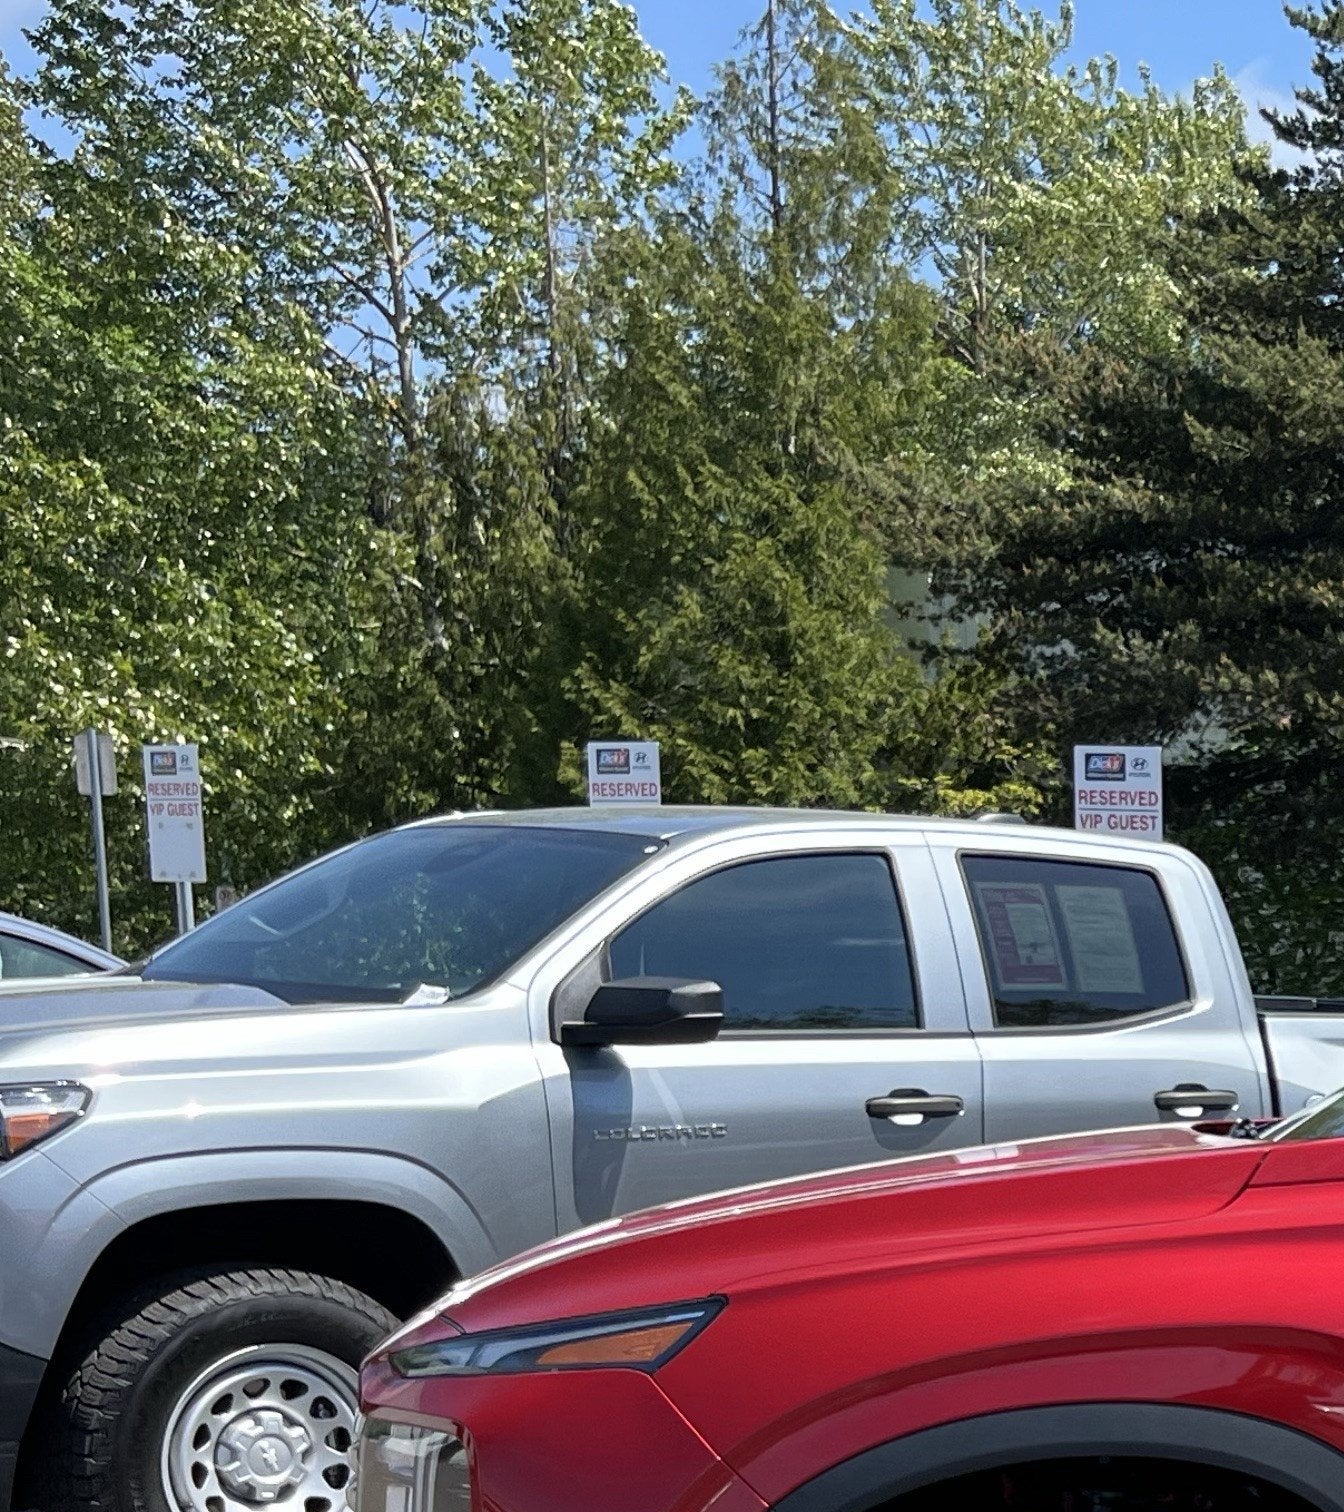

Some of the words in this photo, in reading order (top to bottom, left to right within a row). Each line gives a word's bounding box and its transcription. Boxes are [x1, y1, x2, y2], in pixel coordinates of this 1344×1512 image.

[148, 783, 199, 796] RESERVED
[592, 783, 658, 797] RESERVED
[1079, 790, 1159, 807] RESERVED
[149, 803, 165, 816] VIP
[167, 803, 199, 817] GUEST
[1080, 814, 1103, 829] VIP
[1108, 814, 1159, 831] GUEST
